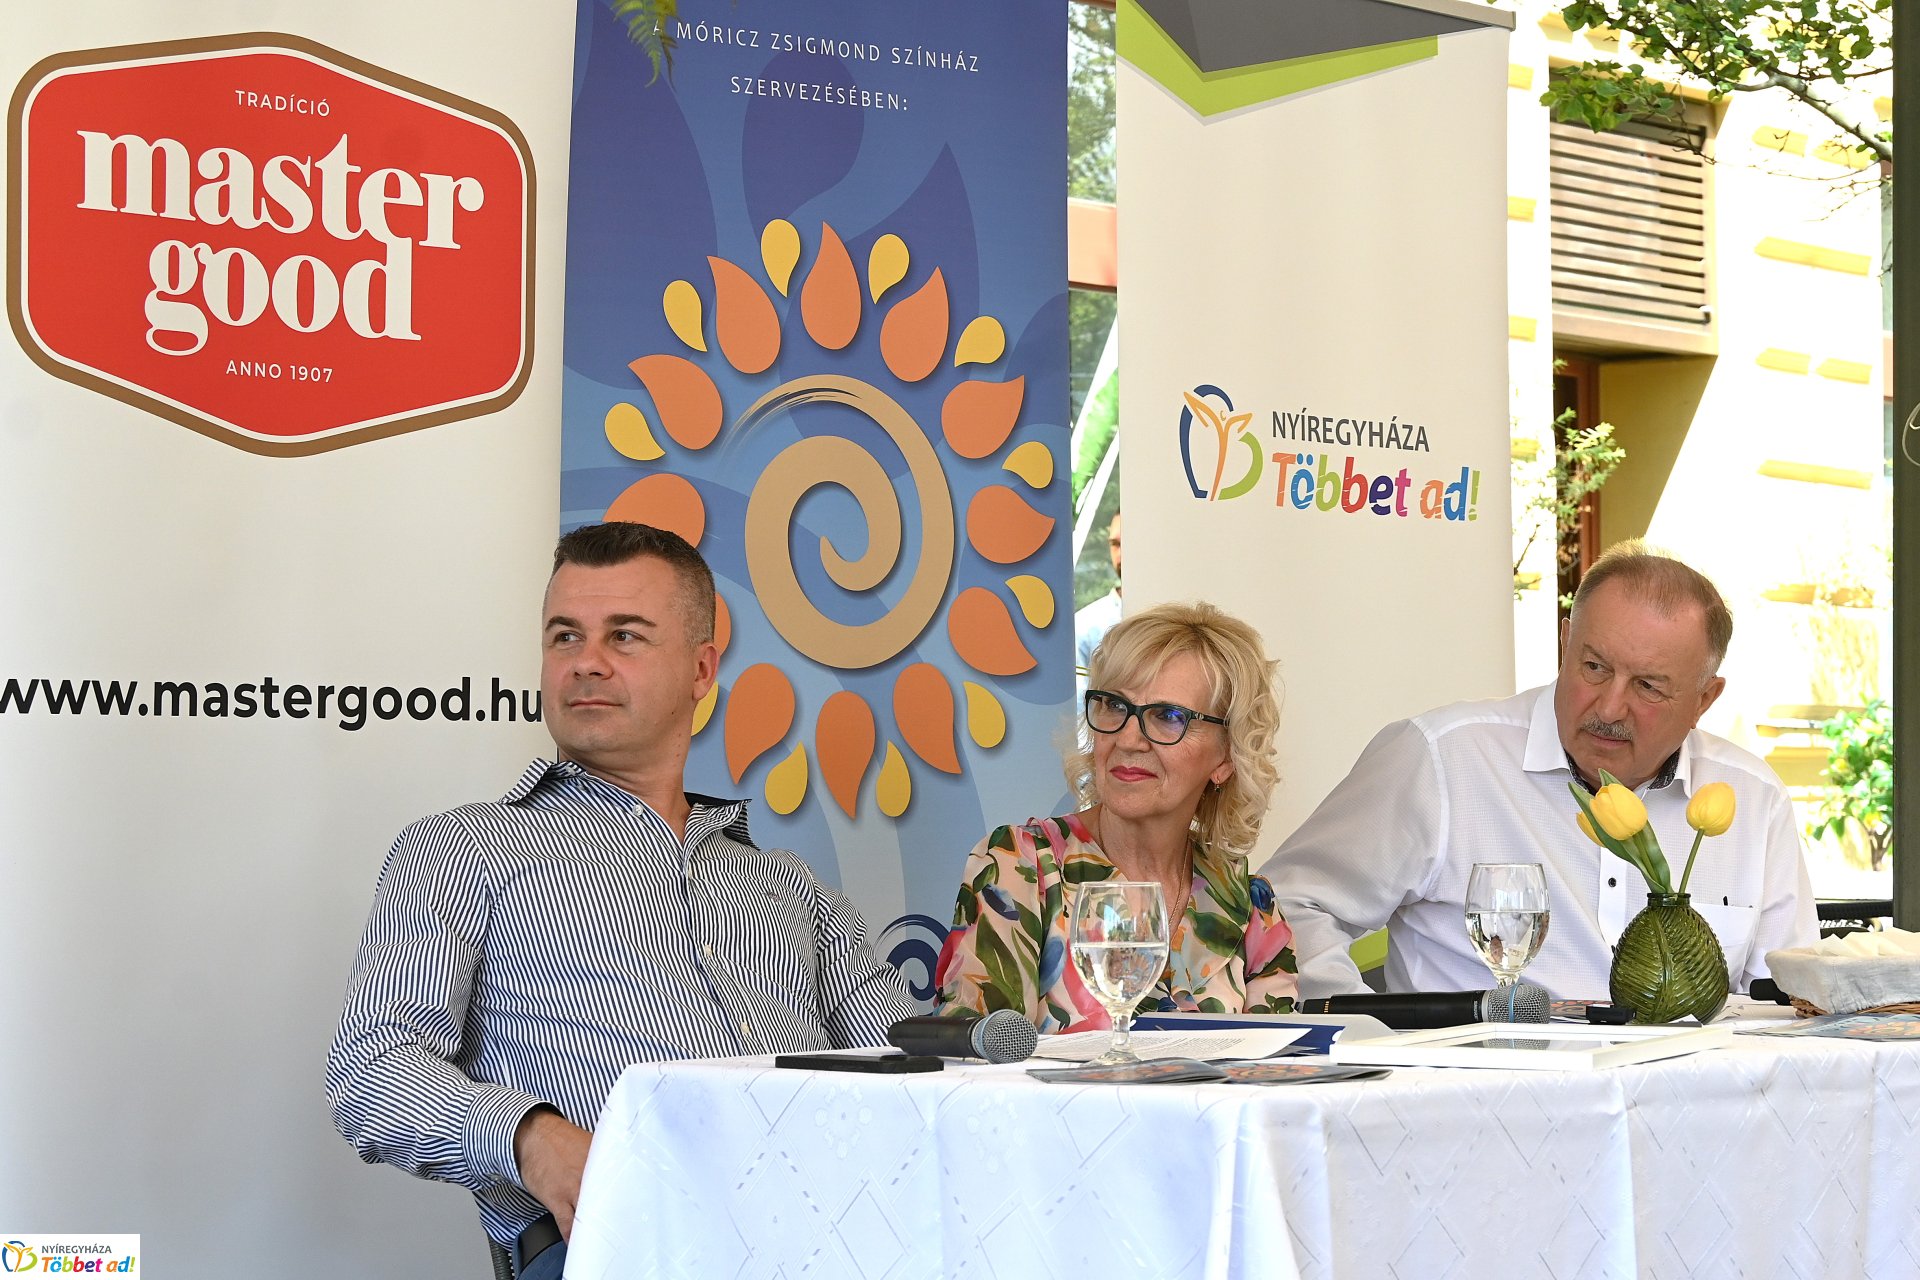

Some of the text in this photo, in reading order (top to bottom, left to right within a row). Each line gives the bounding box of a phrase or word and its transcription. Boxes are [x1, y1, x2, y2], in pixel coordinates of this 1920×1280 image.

[676, 20, 759, 48] MÓRICZ
[770, 32, 880, 62] ZSIGMOND
[891, 45, 979, 73] SZÍNHÁZ
[235, 90, 331, 117] TRADÍCIÓ
[731, 76, 908, 111] SZERVEZÉSÉBEN:
[76, 130, 484, 250] master
[144, 237, 421, 356] good
[226, 360, 333, 383] ANNO 1907
[1272, 407, 1430, 453] NYÍREGYHÁZA
[1272, 452, 1480, 522] Többet ad!
[0, 676, 541, 731] www.mastergood.hu
